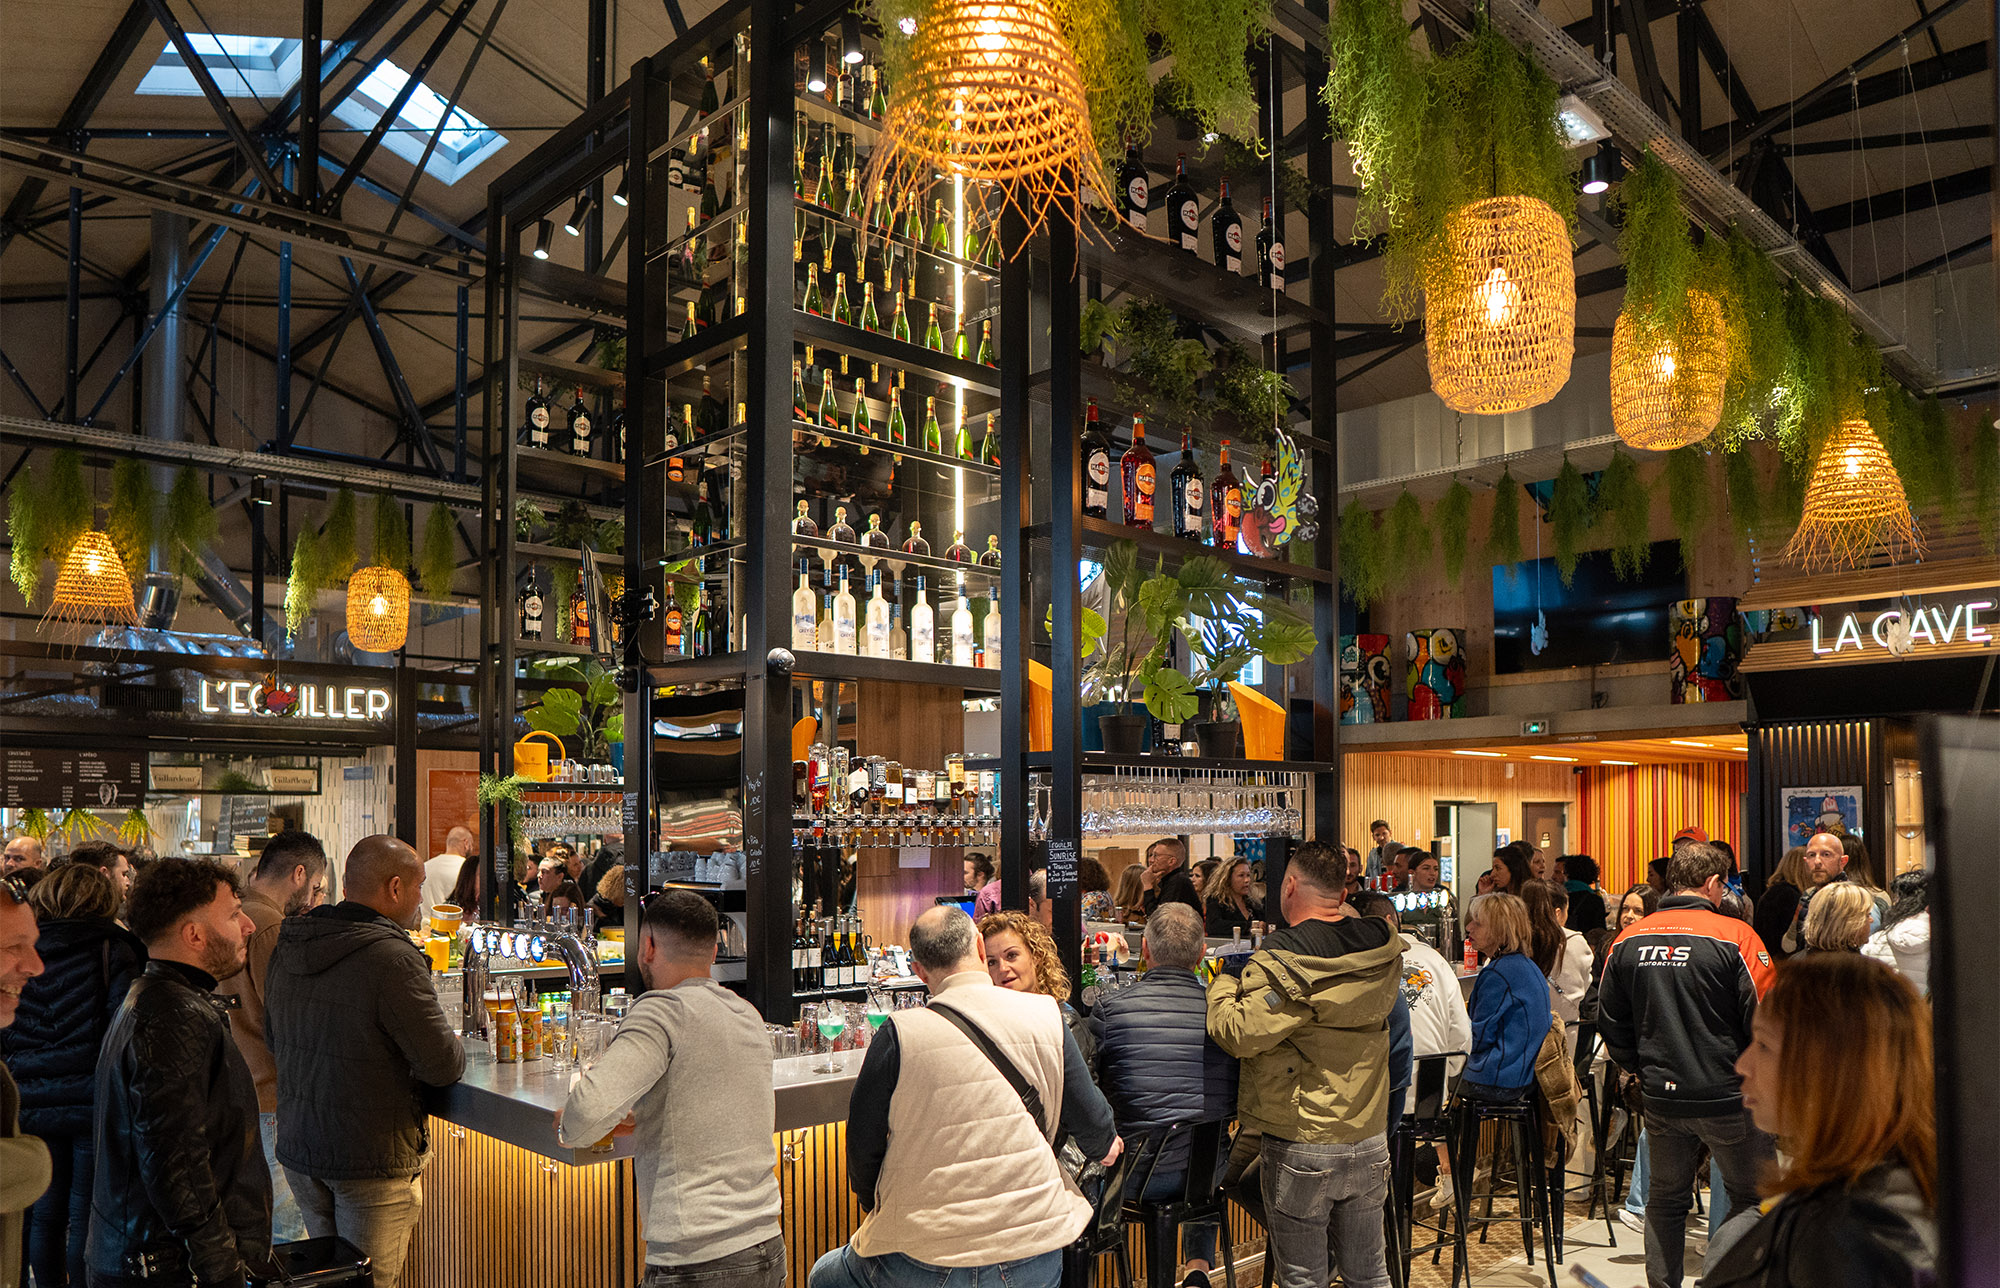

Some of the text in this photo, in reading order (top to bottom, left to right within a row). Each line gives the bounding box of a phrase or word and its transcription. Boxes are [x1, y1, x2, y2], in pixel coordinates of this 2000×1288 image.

[1812, 601, 1993, 654] LA CAVE
[199, 679, 391, 721] L'ECILLER
[1638, 946, 1692, 961] TRS
